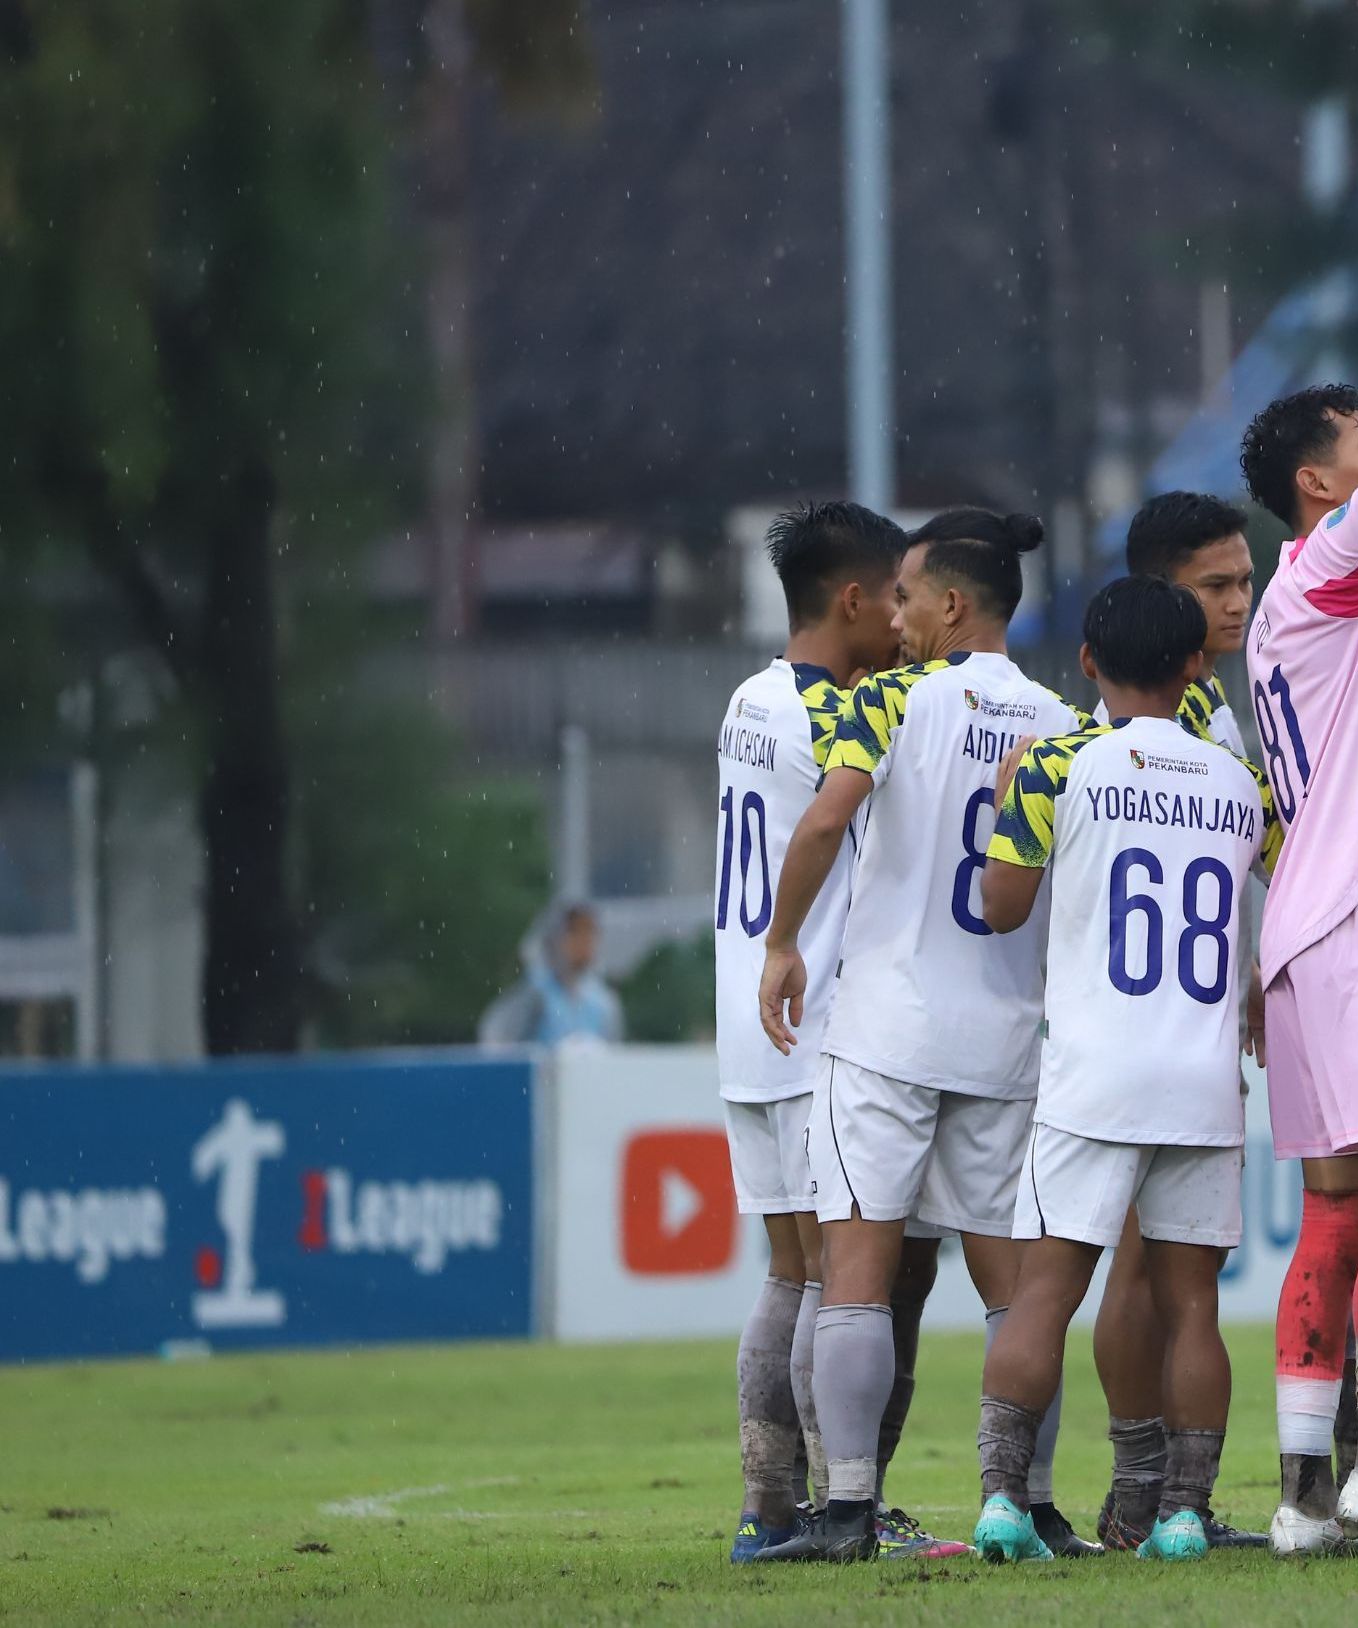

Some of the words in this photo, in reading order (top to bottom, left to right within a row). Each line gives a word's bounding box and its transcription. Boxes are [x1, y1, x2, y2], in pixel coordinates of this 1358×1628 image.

[962, 724, 1021, 764] AIDU
[1147, 755, 1189, 766] PEMERINTAH
[1148, 761, 1209, 776] PEKANBARU
[1254, 662, 1311, 825] 81
[1086, 785, 1256, 843] YOGASANJAYA
[716, 785, 772, 938] 10
[1108, 847, 1234, 1005] 68
